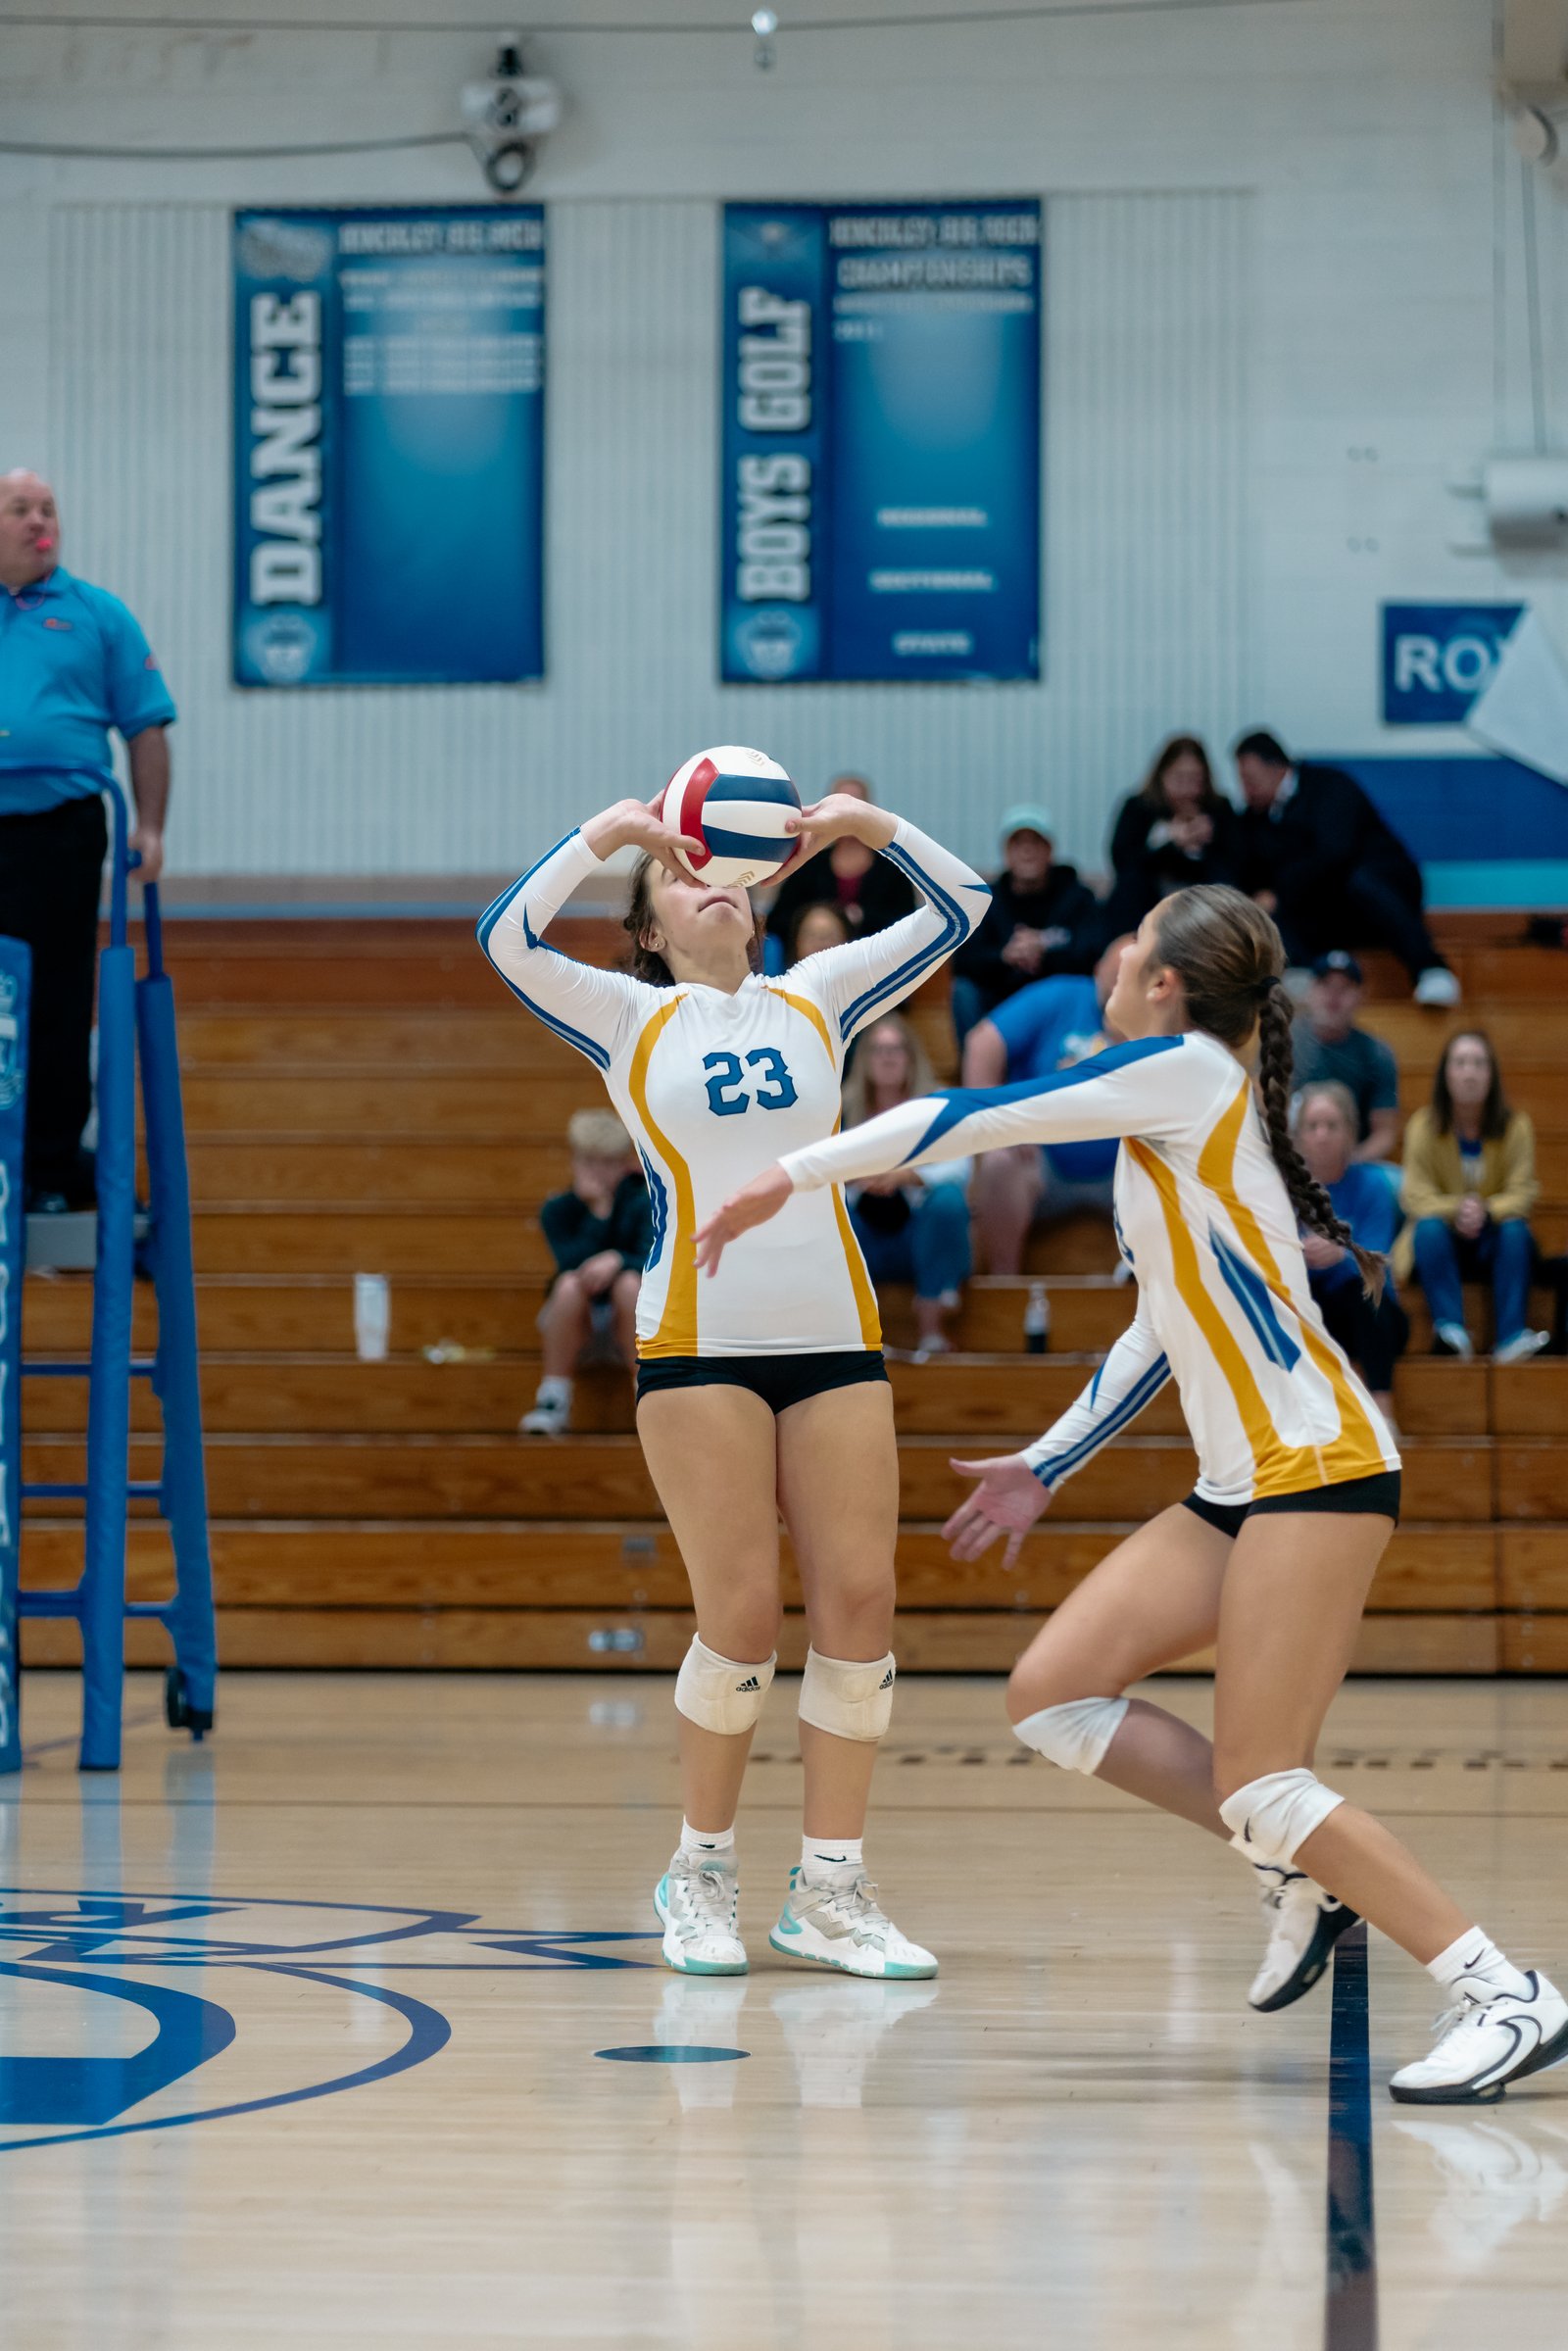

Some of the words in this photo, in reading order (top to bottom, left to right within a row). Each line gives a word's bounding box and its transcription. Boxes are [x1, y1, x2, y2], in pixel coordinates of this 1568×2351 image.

[737, 286, 811, 431] GOLF
[250, 290, 321, 606] DANCE
[737, 454, 811, 602] BOYS
[702, 1048, 799, 1116] 23
